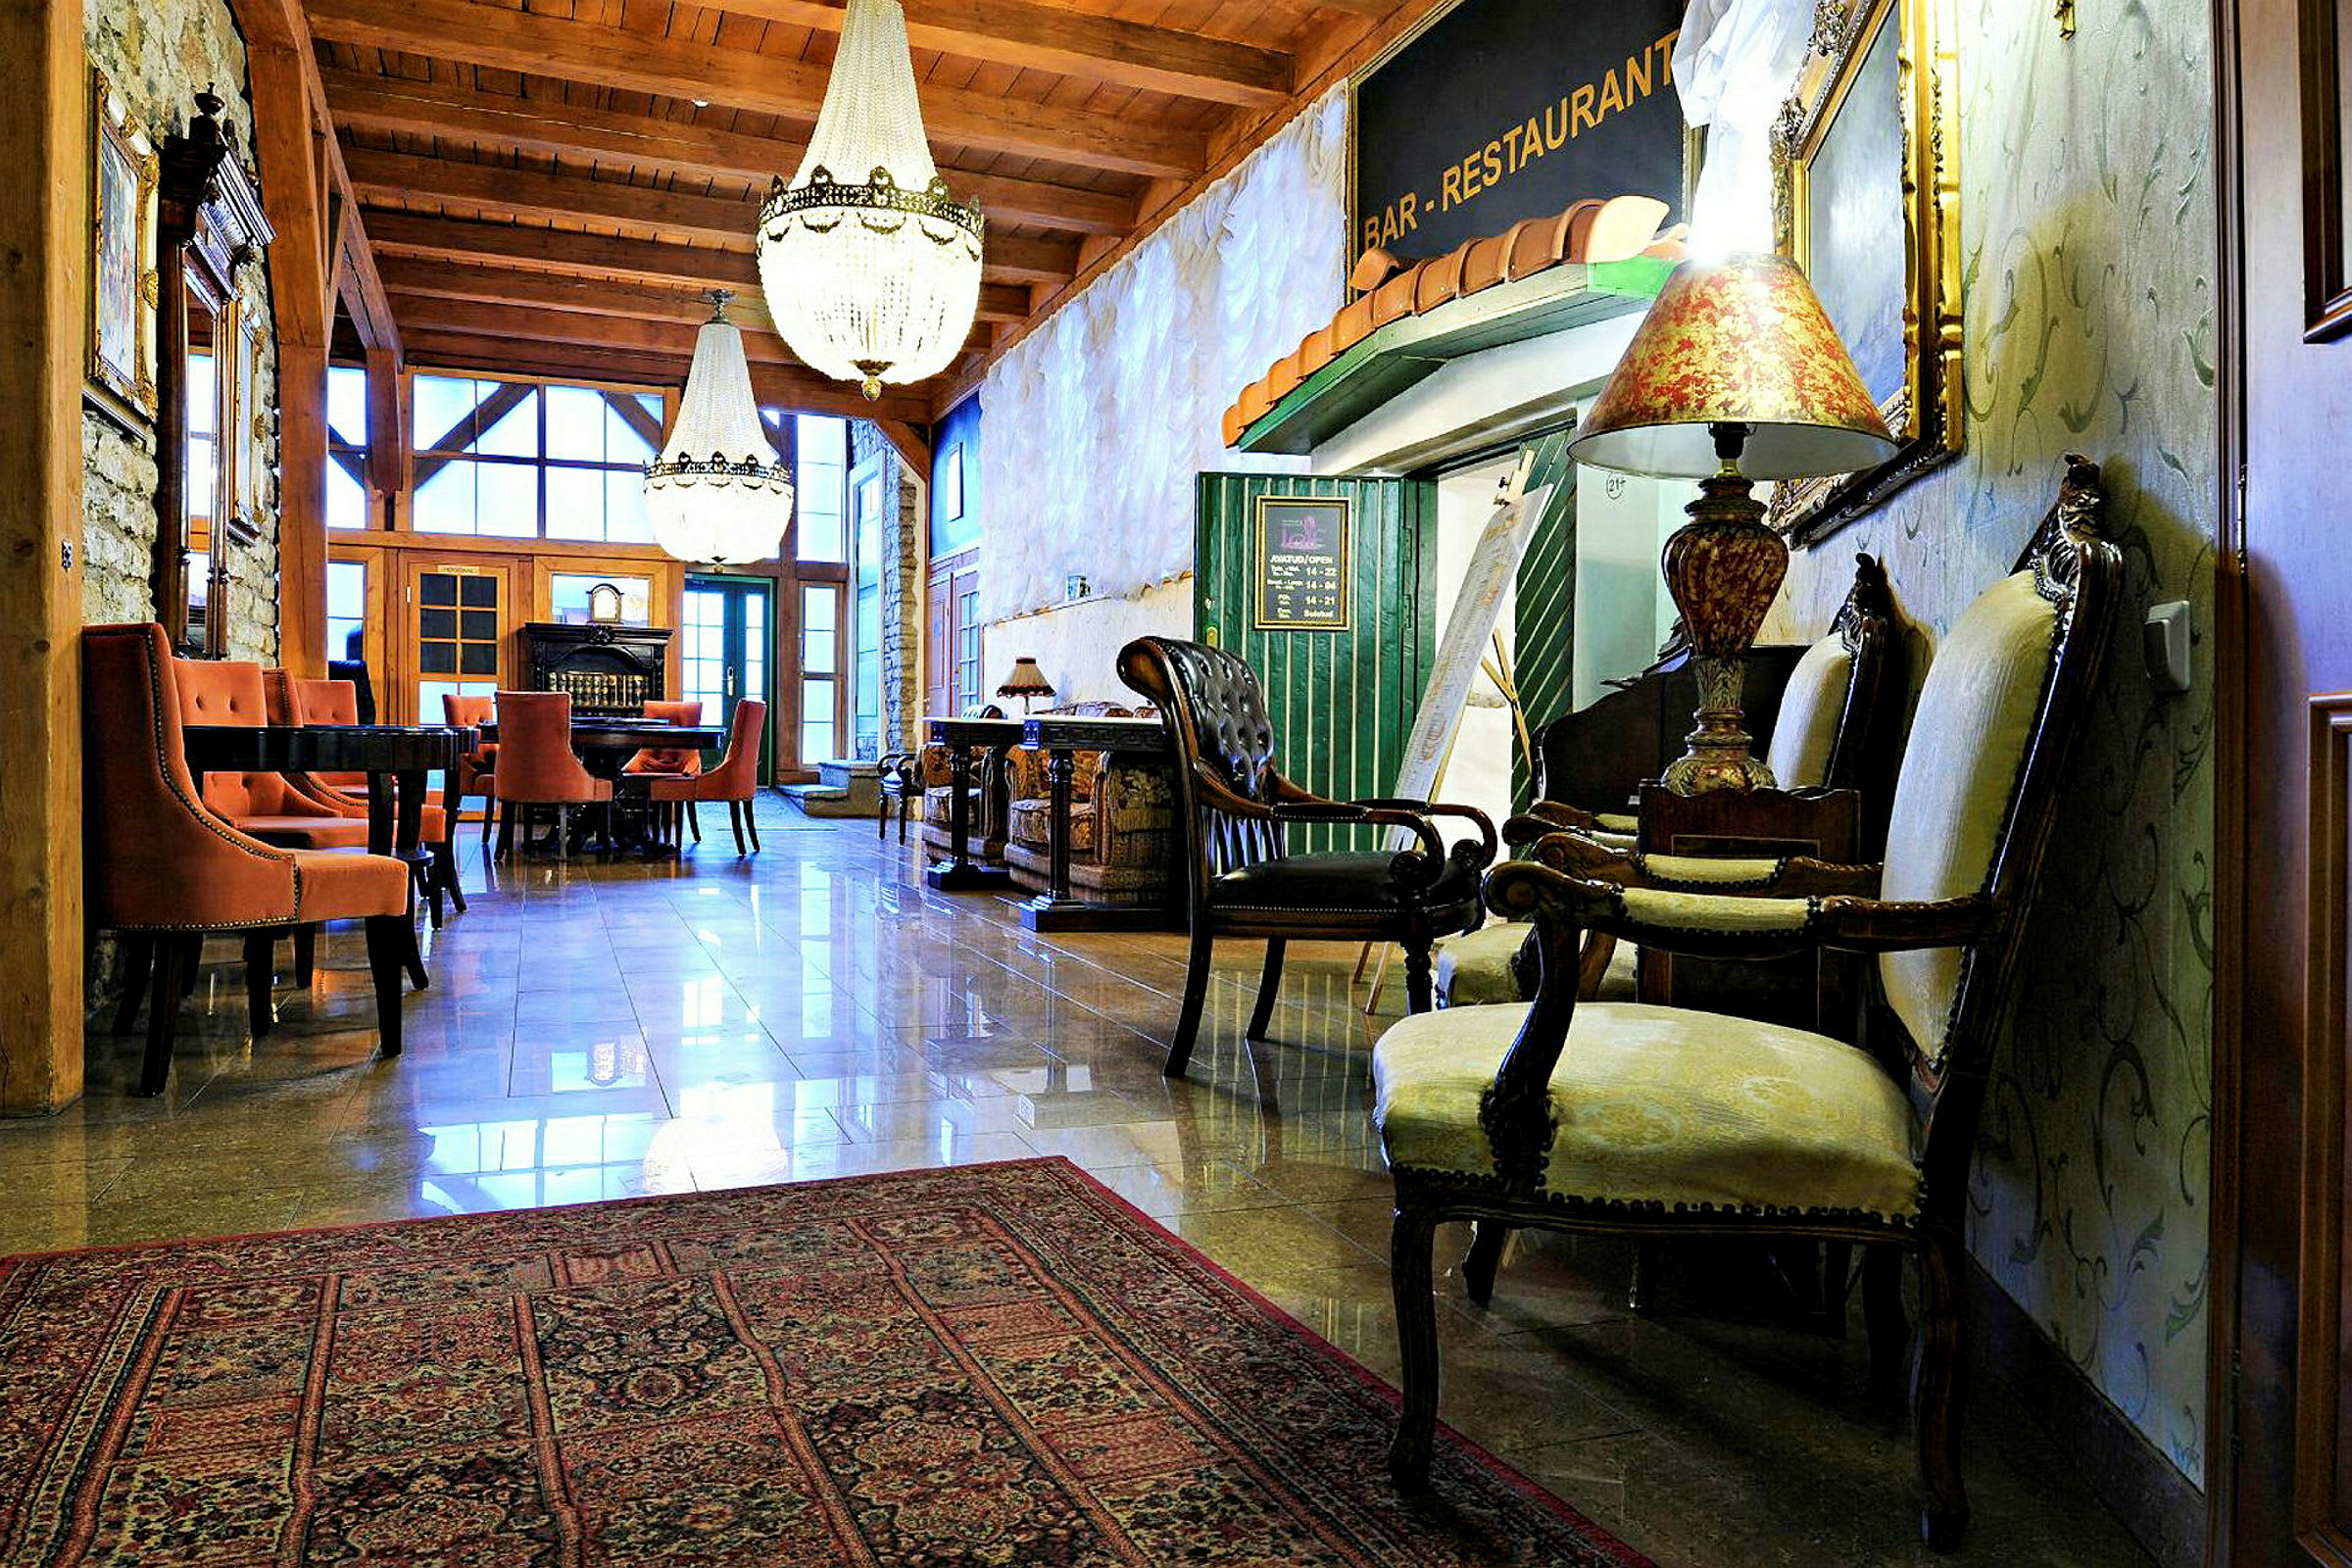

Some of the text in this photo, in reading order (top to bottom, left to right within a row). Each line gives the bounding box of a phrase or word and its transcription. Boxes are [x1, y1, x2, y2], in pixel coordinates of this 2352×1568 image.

[1364, 192, 1417, 249] BAR
[1443, 28, 1679, 212] RESTAURANT
[1306, 567, 1317, 576] 14
[1306, 580, 1317, 589] 14
[1305, 596, 1317, 605] 14
